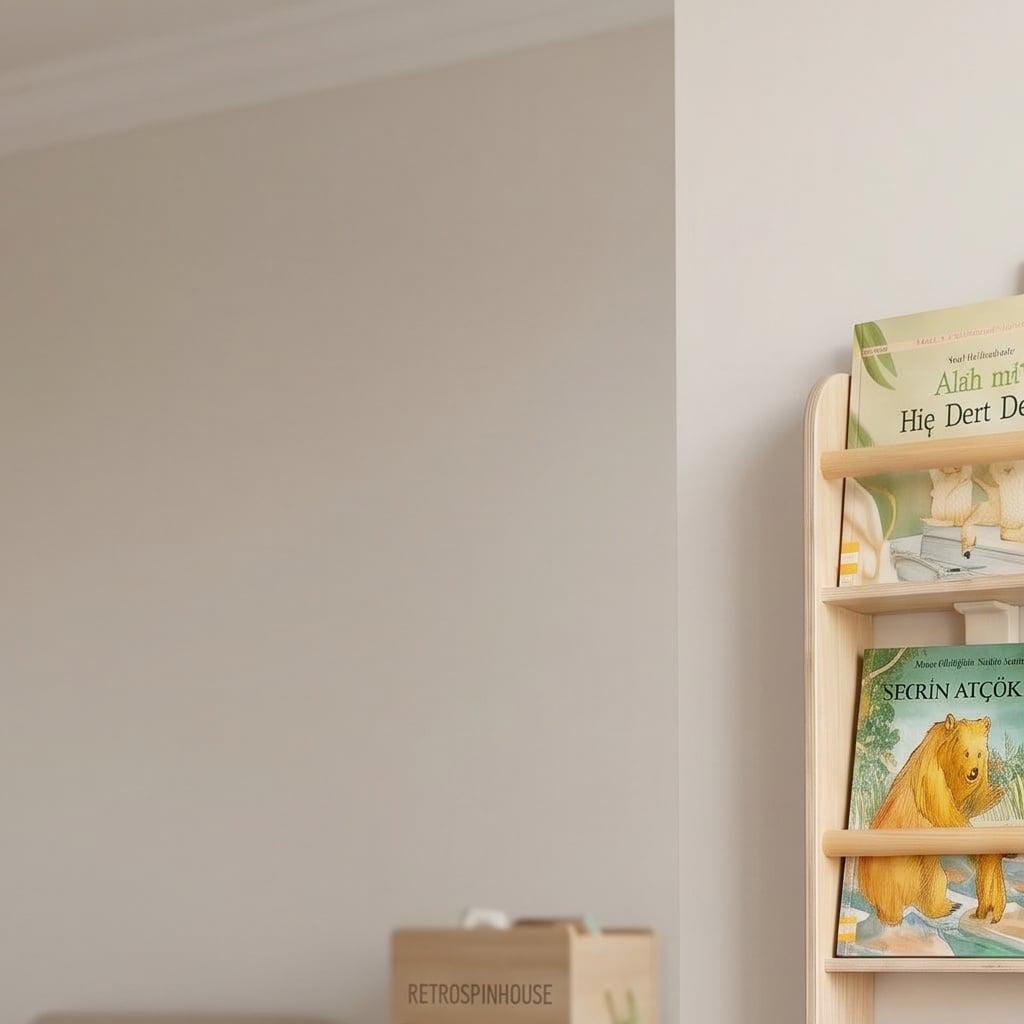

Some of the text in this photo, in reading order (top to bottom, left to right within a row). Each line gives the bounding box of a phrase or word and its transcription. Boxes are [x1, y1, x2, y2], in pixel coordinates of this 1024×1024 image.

[900, 409, 936, 438] Hiç
[945, 401, 992, 428] Dert
[408, 983, 553, 1006] RETROSPINHOUSE
